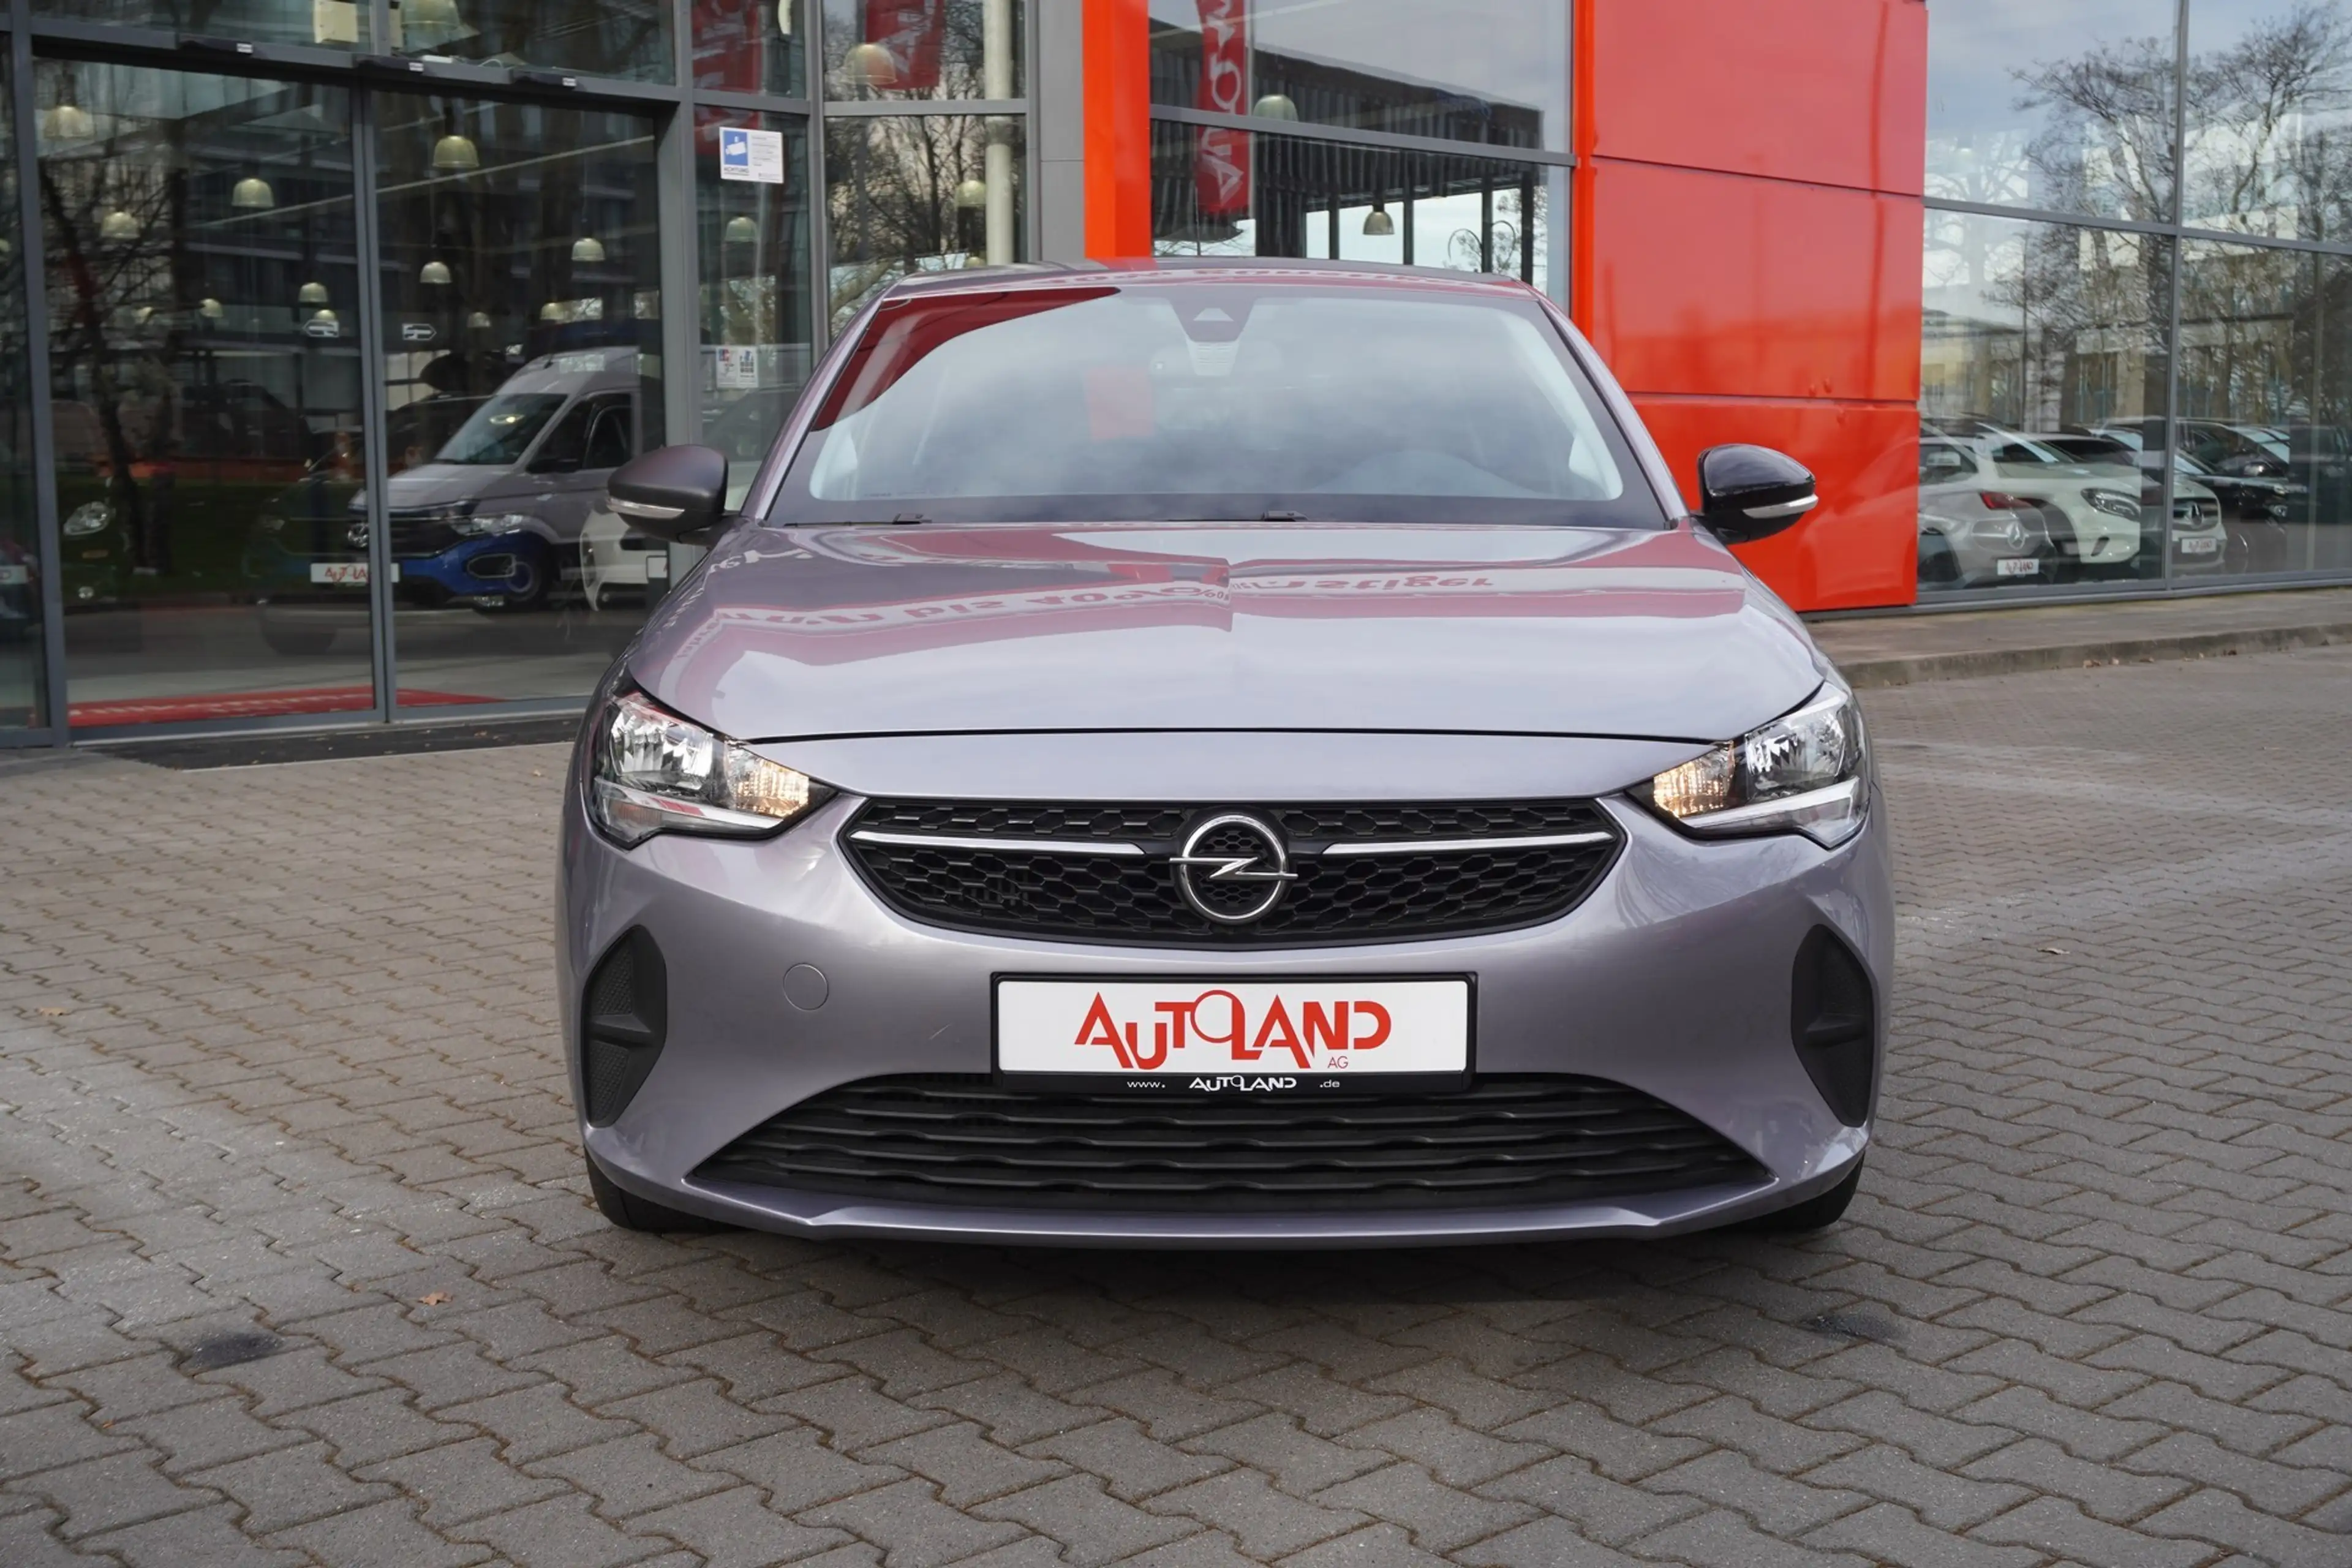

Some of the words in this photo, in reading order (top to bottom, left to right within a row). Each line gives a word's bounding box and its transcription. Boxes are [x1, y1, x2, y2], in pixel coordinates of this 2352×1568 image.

[1074, 990, 1392, 1070] AUTOLAND
[1327, 1056, 1349, 1069] AG
[1189, 1075, 1297, 1091] AUTOLAND
[1319, 1079, 1340, 1088] .de
